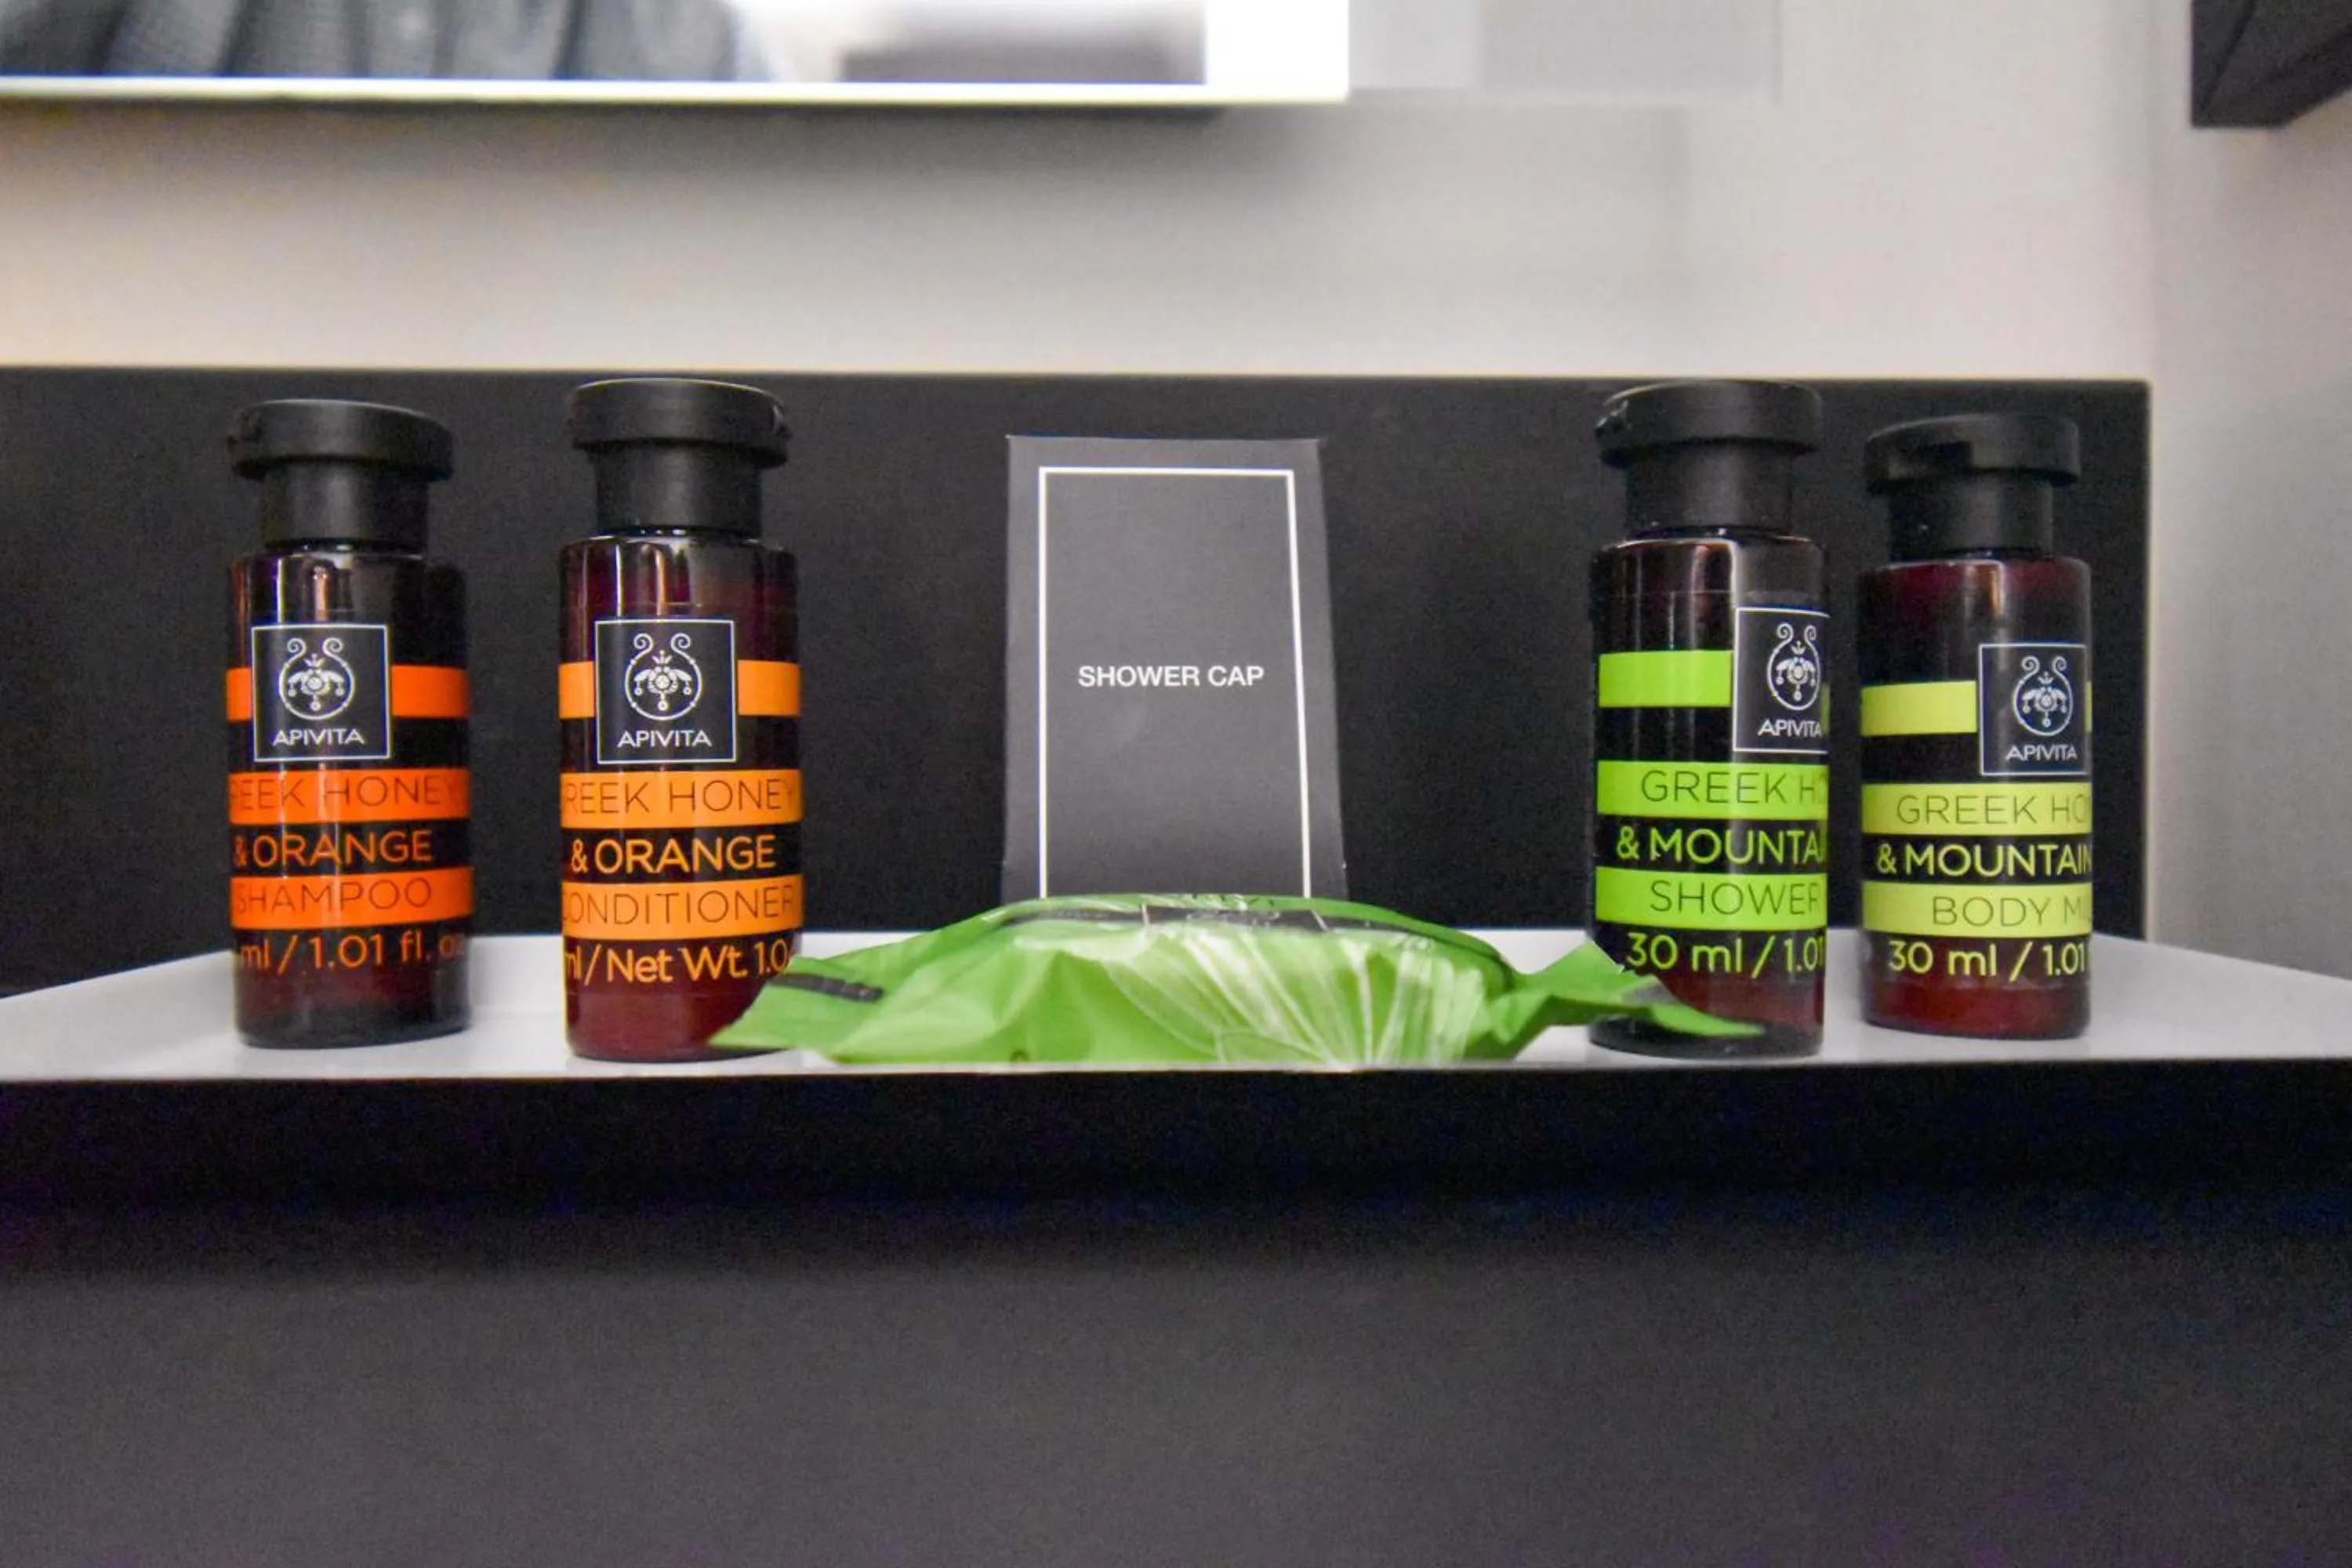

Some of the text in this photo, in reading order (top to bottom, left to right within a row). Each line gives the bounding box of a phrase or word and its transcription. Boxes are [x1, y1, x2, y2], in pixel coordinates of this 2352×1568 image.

[1078, 665, 1265, 688] SHOWER CAP
[273, 728, 365, 747] APIVITA
[617, 729, 713, 748] APIVITA
[1756, 717, 1823, 739] APIVITA
[2004, 743, 2078, 762] APIVITA
[1640, 769, 1787, 804] GREEK
[1895, 793, 2038, 826] GREEK
[252, 829, 434, 868] ORANGE
[593, 834, 777, 875] ORANGE
[234, 876, 433, 916] SHAMPOO
[563, 884, 793, 926] ONDITIONER
[1649, 879, 1820, 916] SHOWER
[1931, 895, 2052, 928] BODY
[311, 931, 383, 969] 1.01
[1626, 932, 1679, 971] 30
[1690, 936, 1744, 975] ml
[1889, 939, 1934, 975] 30
[1947, 942, 1998, 978] ml
[2042, 942, 2085, 978] 1.01
